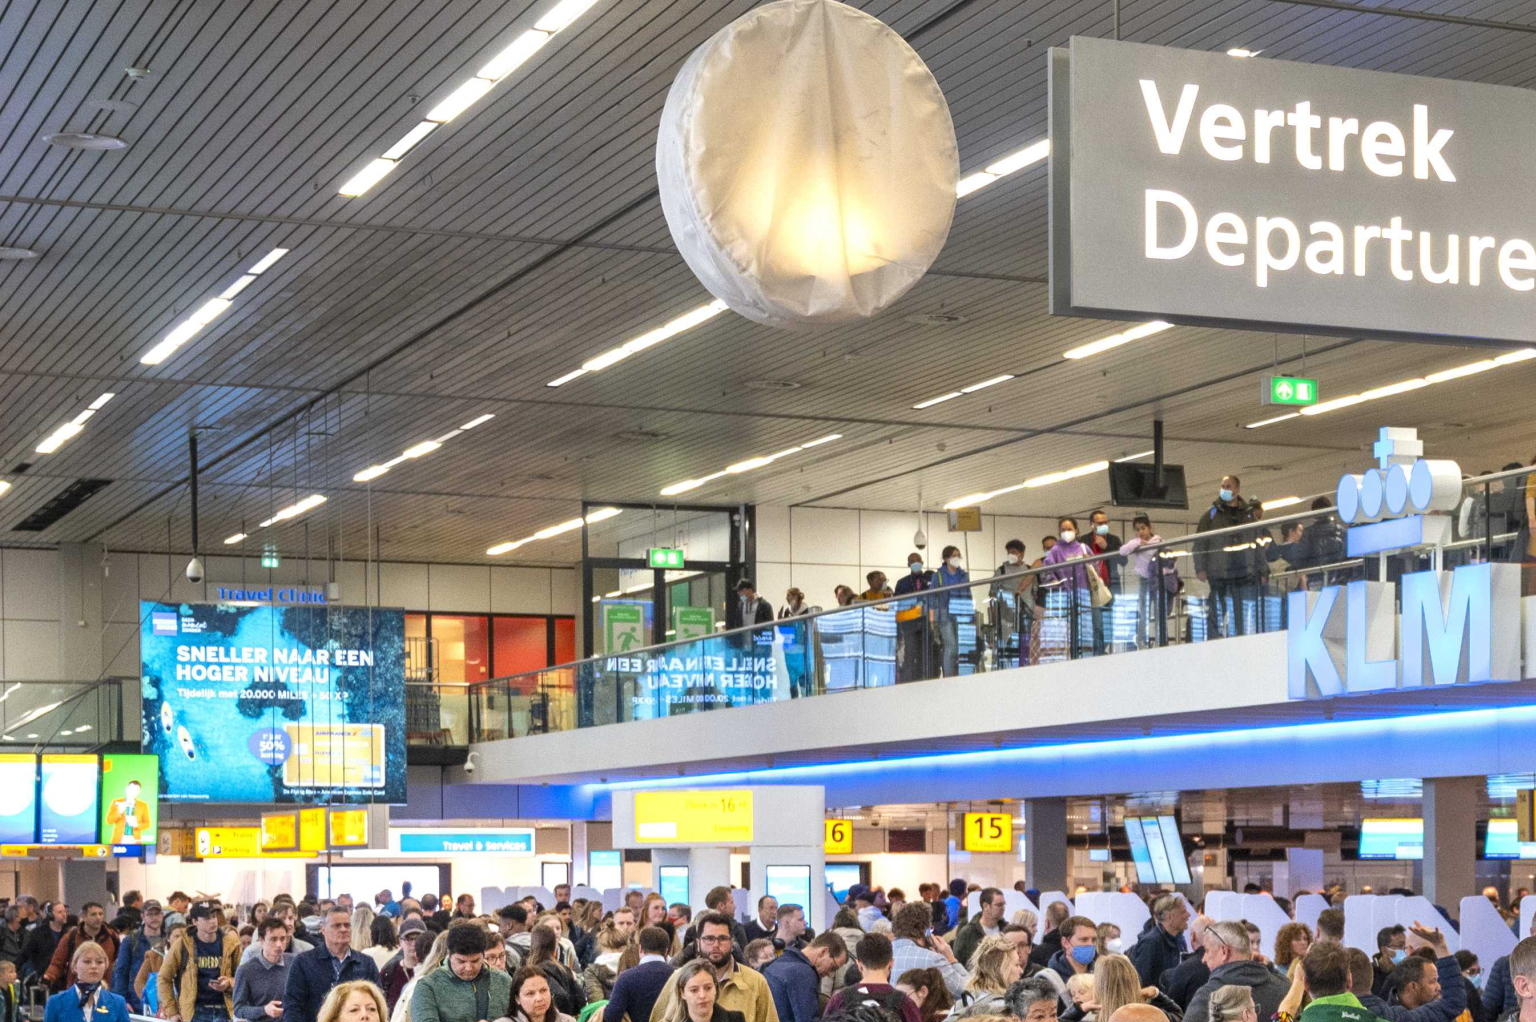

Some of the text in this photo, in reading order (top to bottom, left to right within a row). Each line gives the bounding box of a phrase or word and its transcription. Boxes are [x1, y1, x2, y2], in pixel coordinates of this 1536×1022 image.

[1138, 78, 1457, 183] Vertrek
[216, 586, 273, 601] Travel
[1288, 561, 1522, 700] KLM
[176, 645, 374, 667] SNELLER NAAR EEN
[176, 664, 329, 684] HOGER NIVEAU
[240, 690, 276, 699] 20.000
[974, 816, 1003, 840] 15
